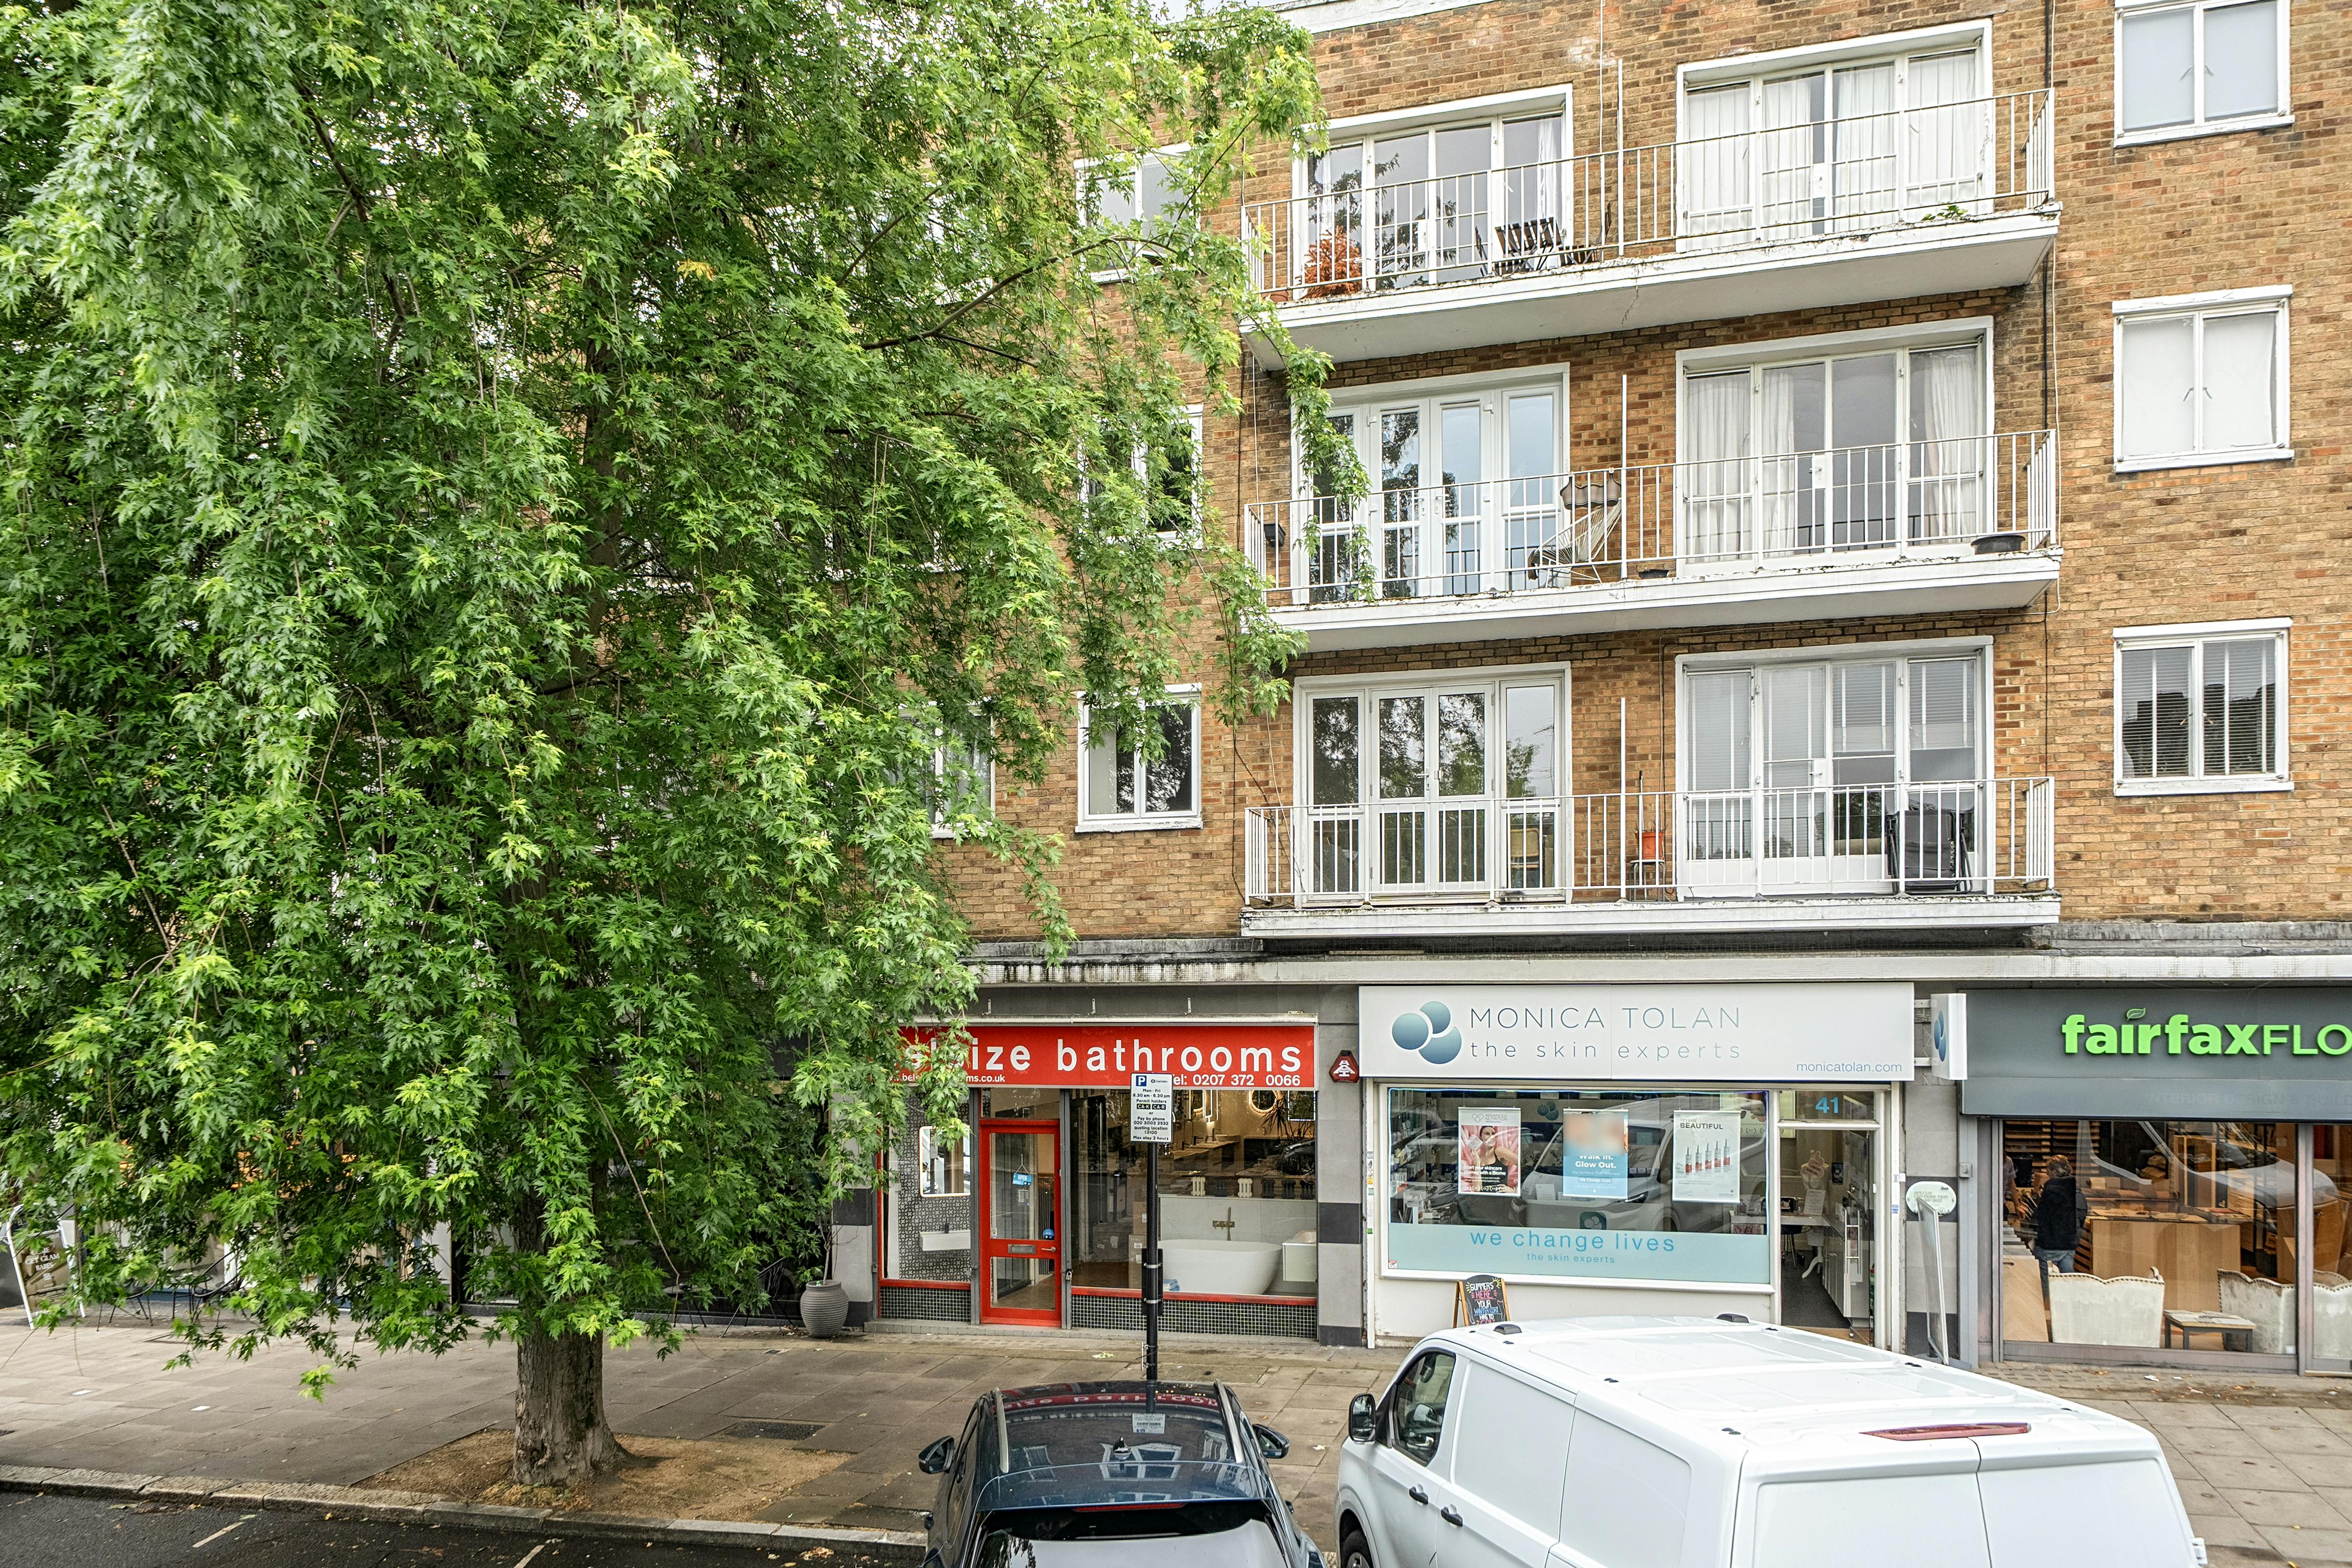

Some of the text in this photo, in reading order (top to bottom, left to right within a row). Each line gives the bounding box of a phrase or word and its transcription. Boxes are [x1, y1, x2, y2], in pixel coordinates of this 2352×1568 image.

[1471, 1007, 1739, 1029] MONICA TOLAN
[1057, 1039, 1302, 1072] bathrooms
[1471, 1041, 1739, 1061] the skin experts
[1796, 1061, 1902, 1072] monicatolan.com
[1138, 1076, 1146, 1086] P
[1173, 1073, 1301, 1086] el: 0207 372 0066
[1815, 1096, 1839, 1114] 41
[1470, 1230, 1675, 1252] we change lives
[1527, 1253, 1615, 1264] the skin experts
[1477, 1300, 1491, 1308] YOUR
